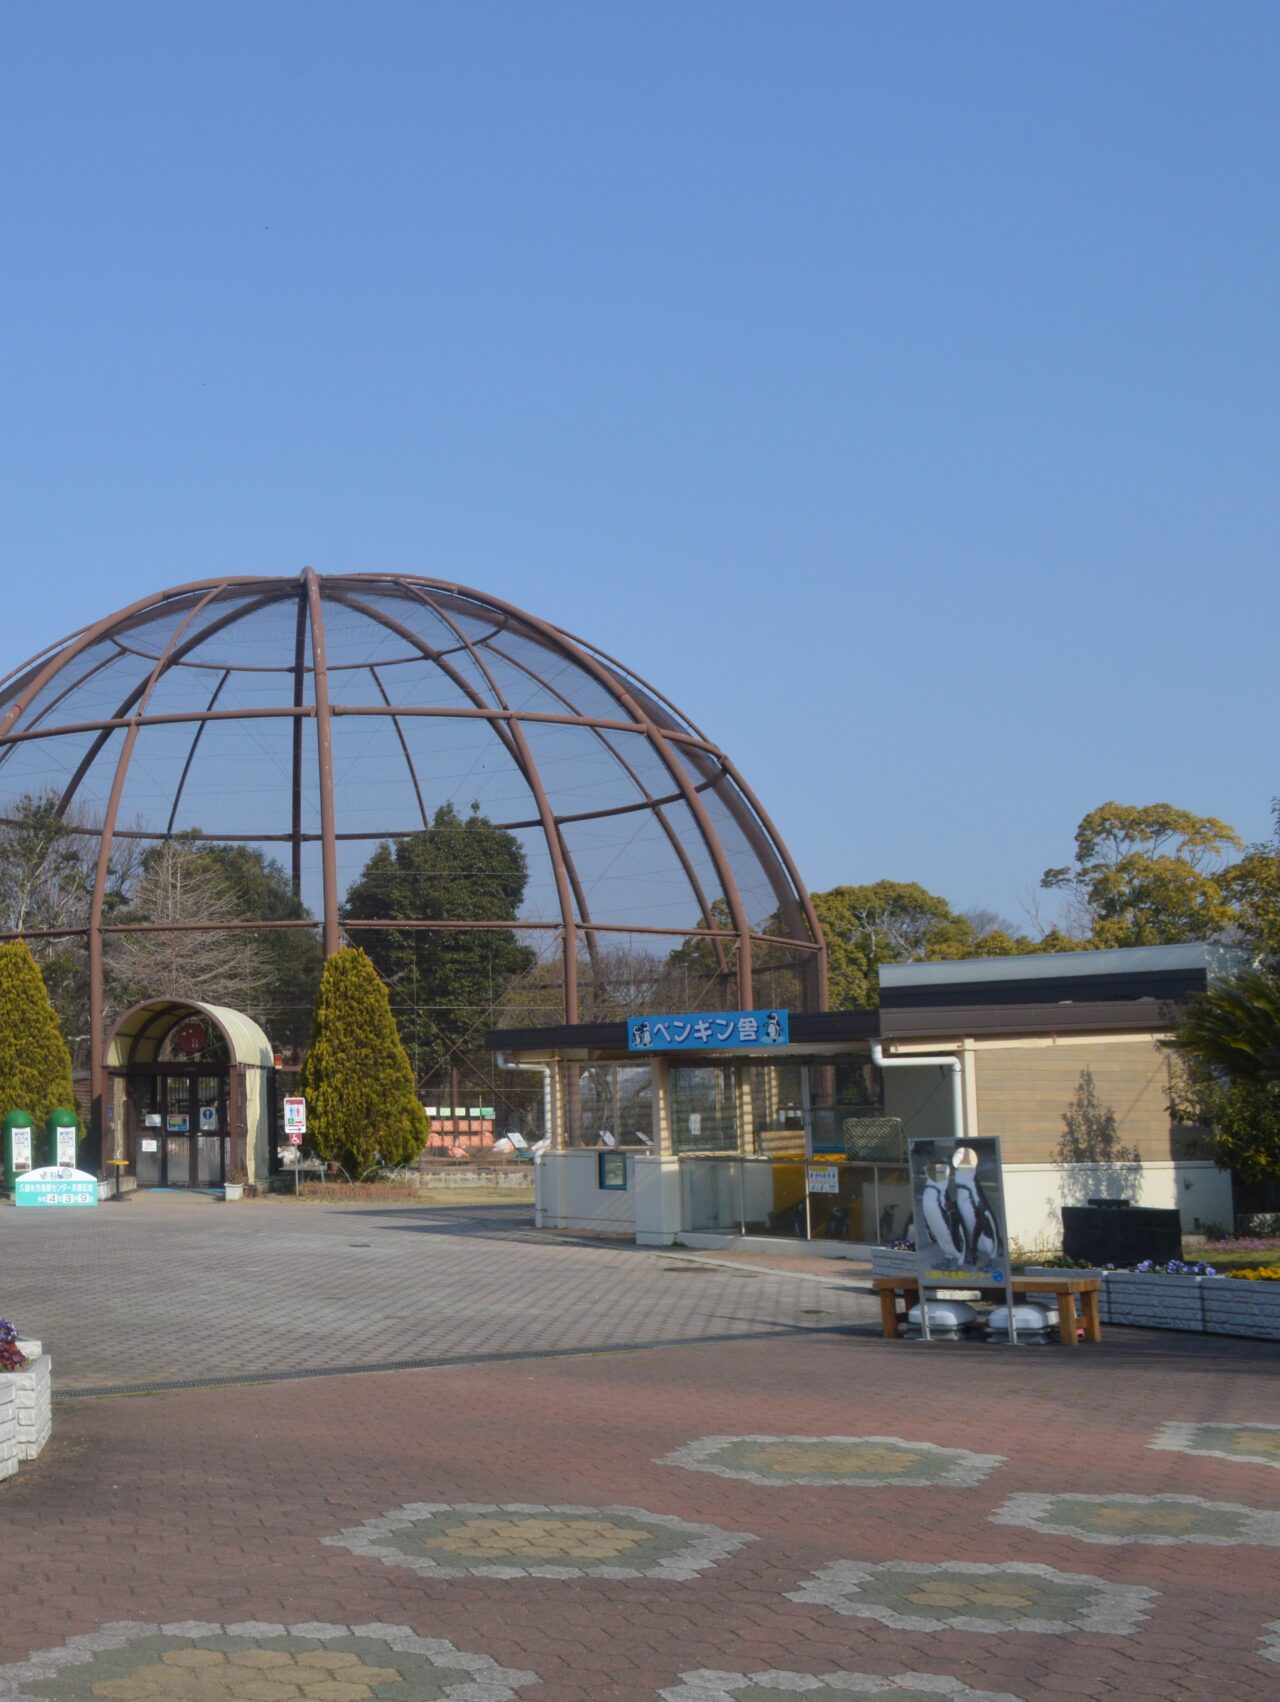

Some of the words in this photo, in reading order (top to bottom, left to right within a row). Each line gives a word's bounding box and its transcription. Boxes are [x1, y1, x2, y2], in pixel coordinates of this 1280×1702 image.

[653, 1016, 758, 1043] ペンギン舎
